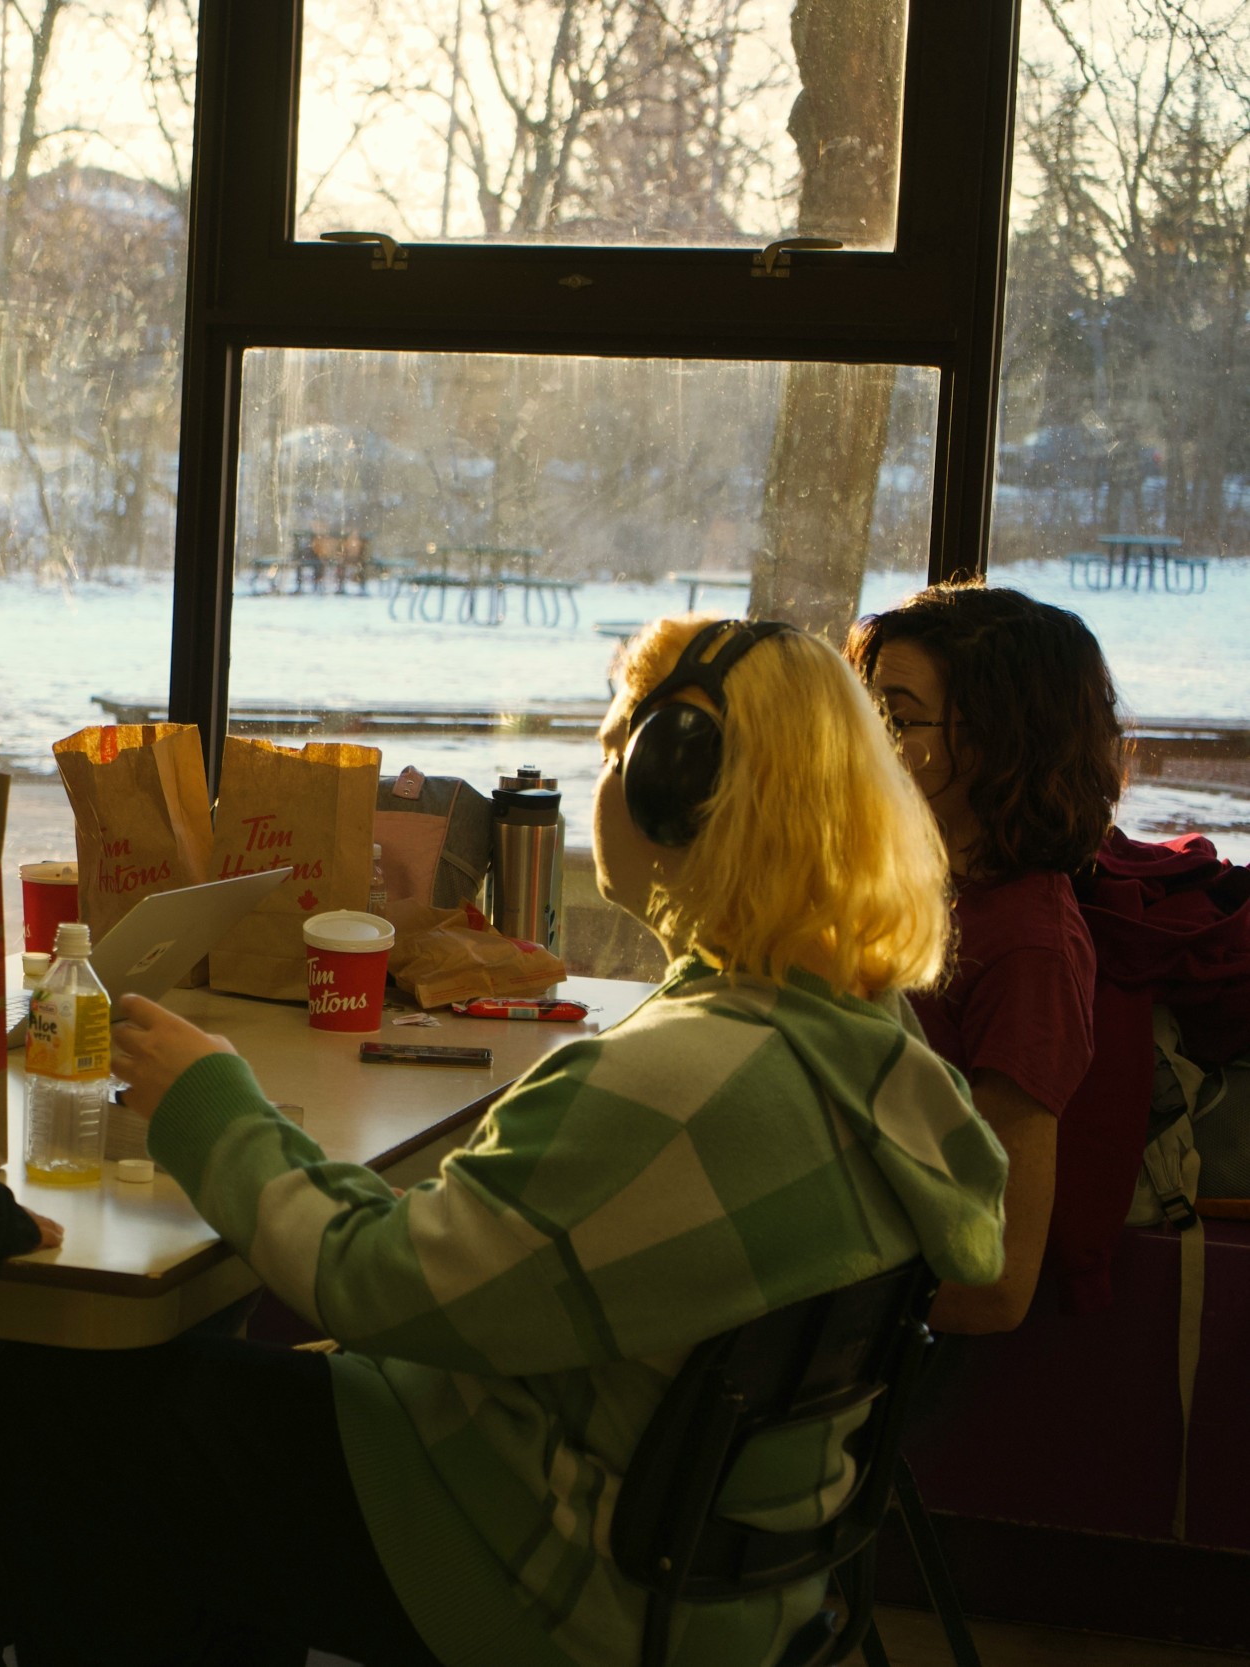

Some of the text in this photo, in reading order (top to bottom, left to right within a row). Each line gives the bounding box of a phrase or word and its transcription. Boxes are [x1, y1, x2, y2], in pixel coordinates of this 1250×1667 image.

[241, 813, 294, 852] Tim
[217, 853, 324, 882] Htns
[306, 956, 335, 987] Tim
[308, 989, 367, 1016] ortons
[29, 1014, 58, 1035] Aloe
[33, 1031, 51, 1042] vera
